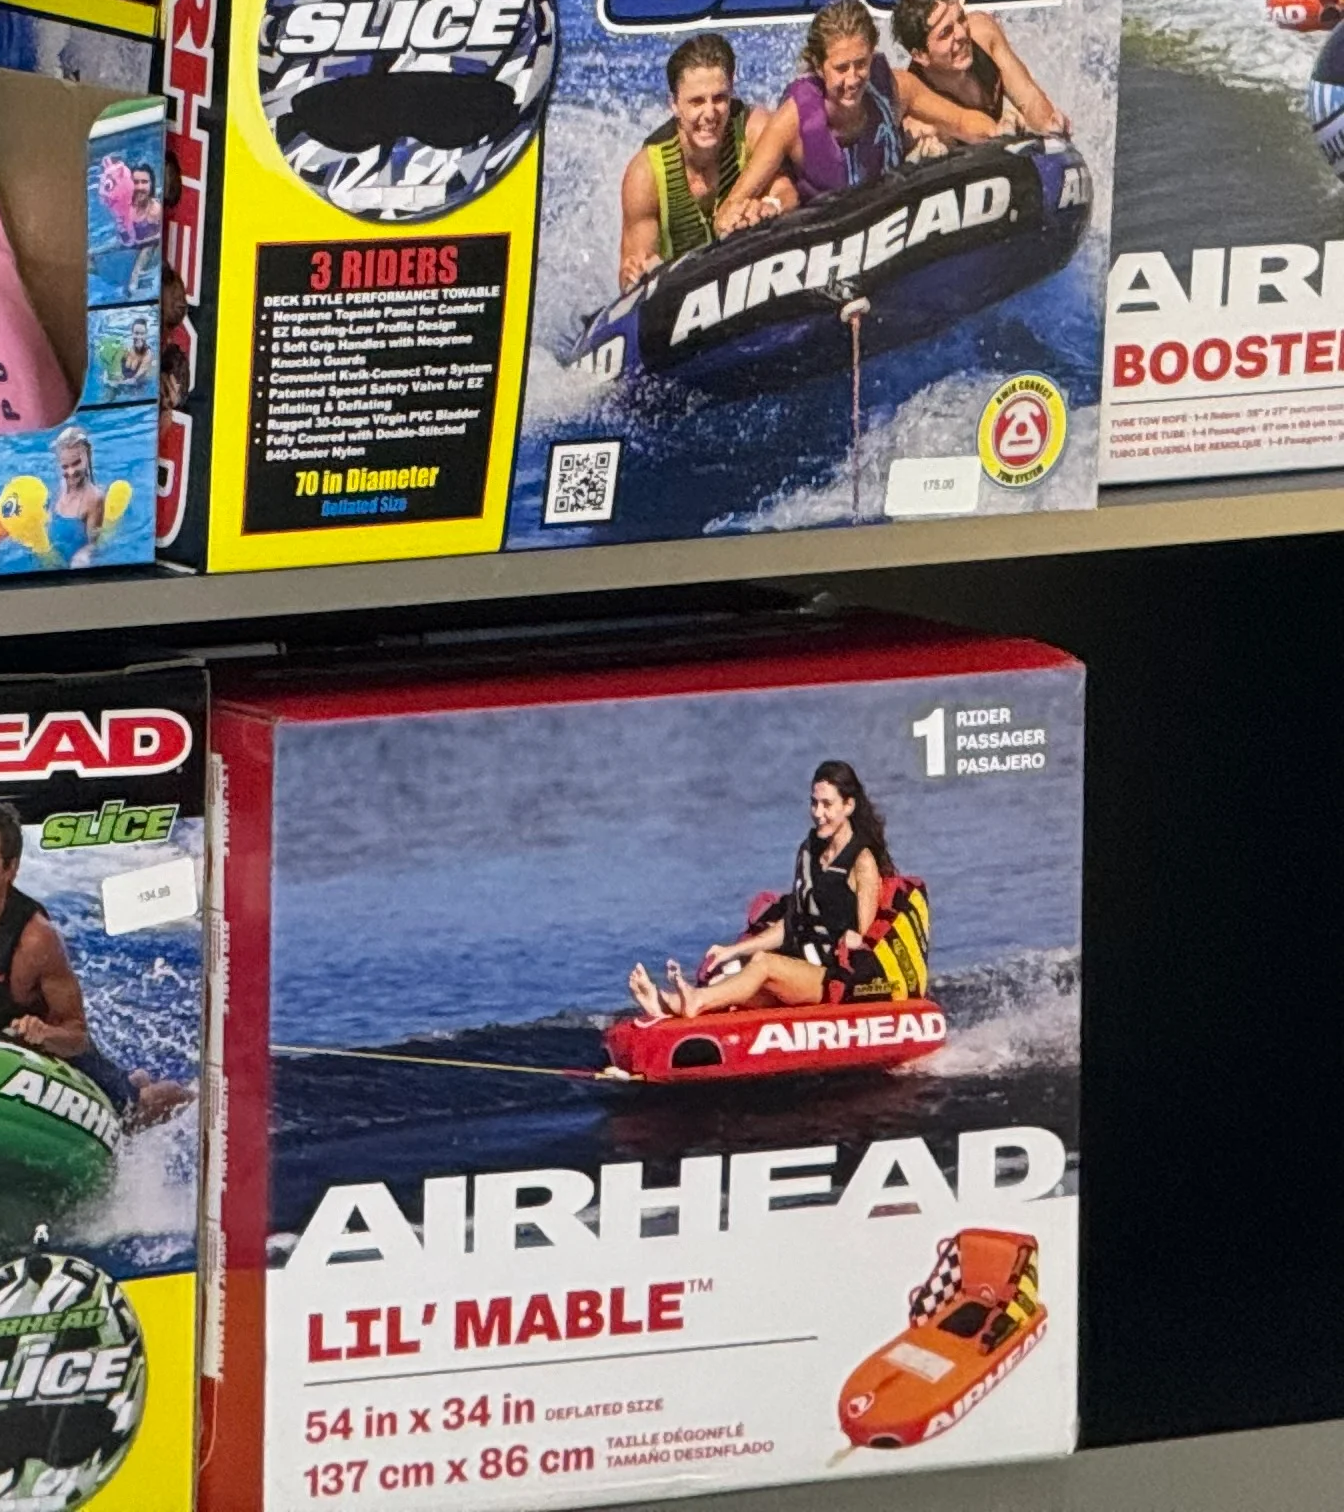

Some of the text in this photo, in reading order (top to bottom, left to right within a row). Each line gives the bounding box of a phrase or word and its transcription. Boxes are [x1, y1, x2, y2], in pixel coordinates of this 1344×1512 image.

[310, 246, 459, 290] 3 RIDERS
[669, 177, 1013, 346] AIRHEAD
[264, 286, 500, 308] DECK STYLE PERFORMANCE TOWABLE
[1113, 330, 1344, 388] BOOSTE
[269, 379, 444, 400] Patented Speed Safety Valve
[296, 465, 440, 496] 70 in Diameter
[913, 708, 1012, 777] 1 RIDER
[956, 728, 1046, 751] PASSAGER
[956, 752, 1046, 774] PASAJERO
[748, 1012, 946, 1056] AIRHEAD
[287, 1126, 1069, 1269] AIRHEAD
[307, 1282, 685, 1364] LIL' MABLE
[305, 1395, 664, 1444] 54 in x 34 in DEFLATED SIZE
[605, 1421, 745, 1450] TAILLE DÉGONFLÉ
[305, 1445, 596, 1500] 137 cm x 86 cm
[605, 1439, 775, 1469] TAMAÑO DESINFLADO
